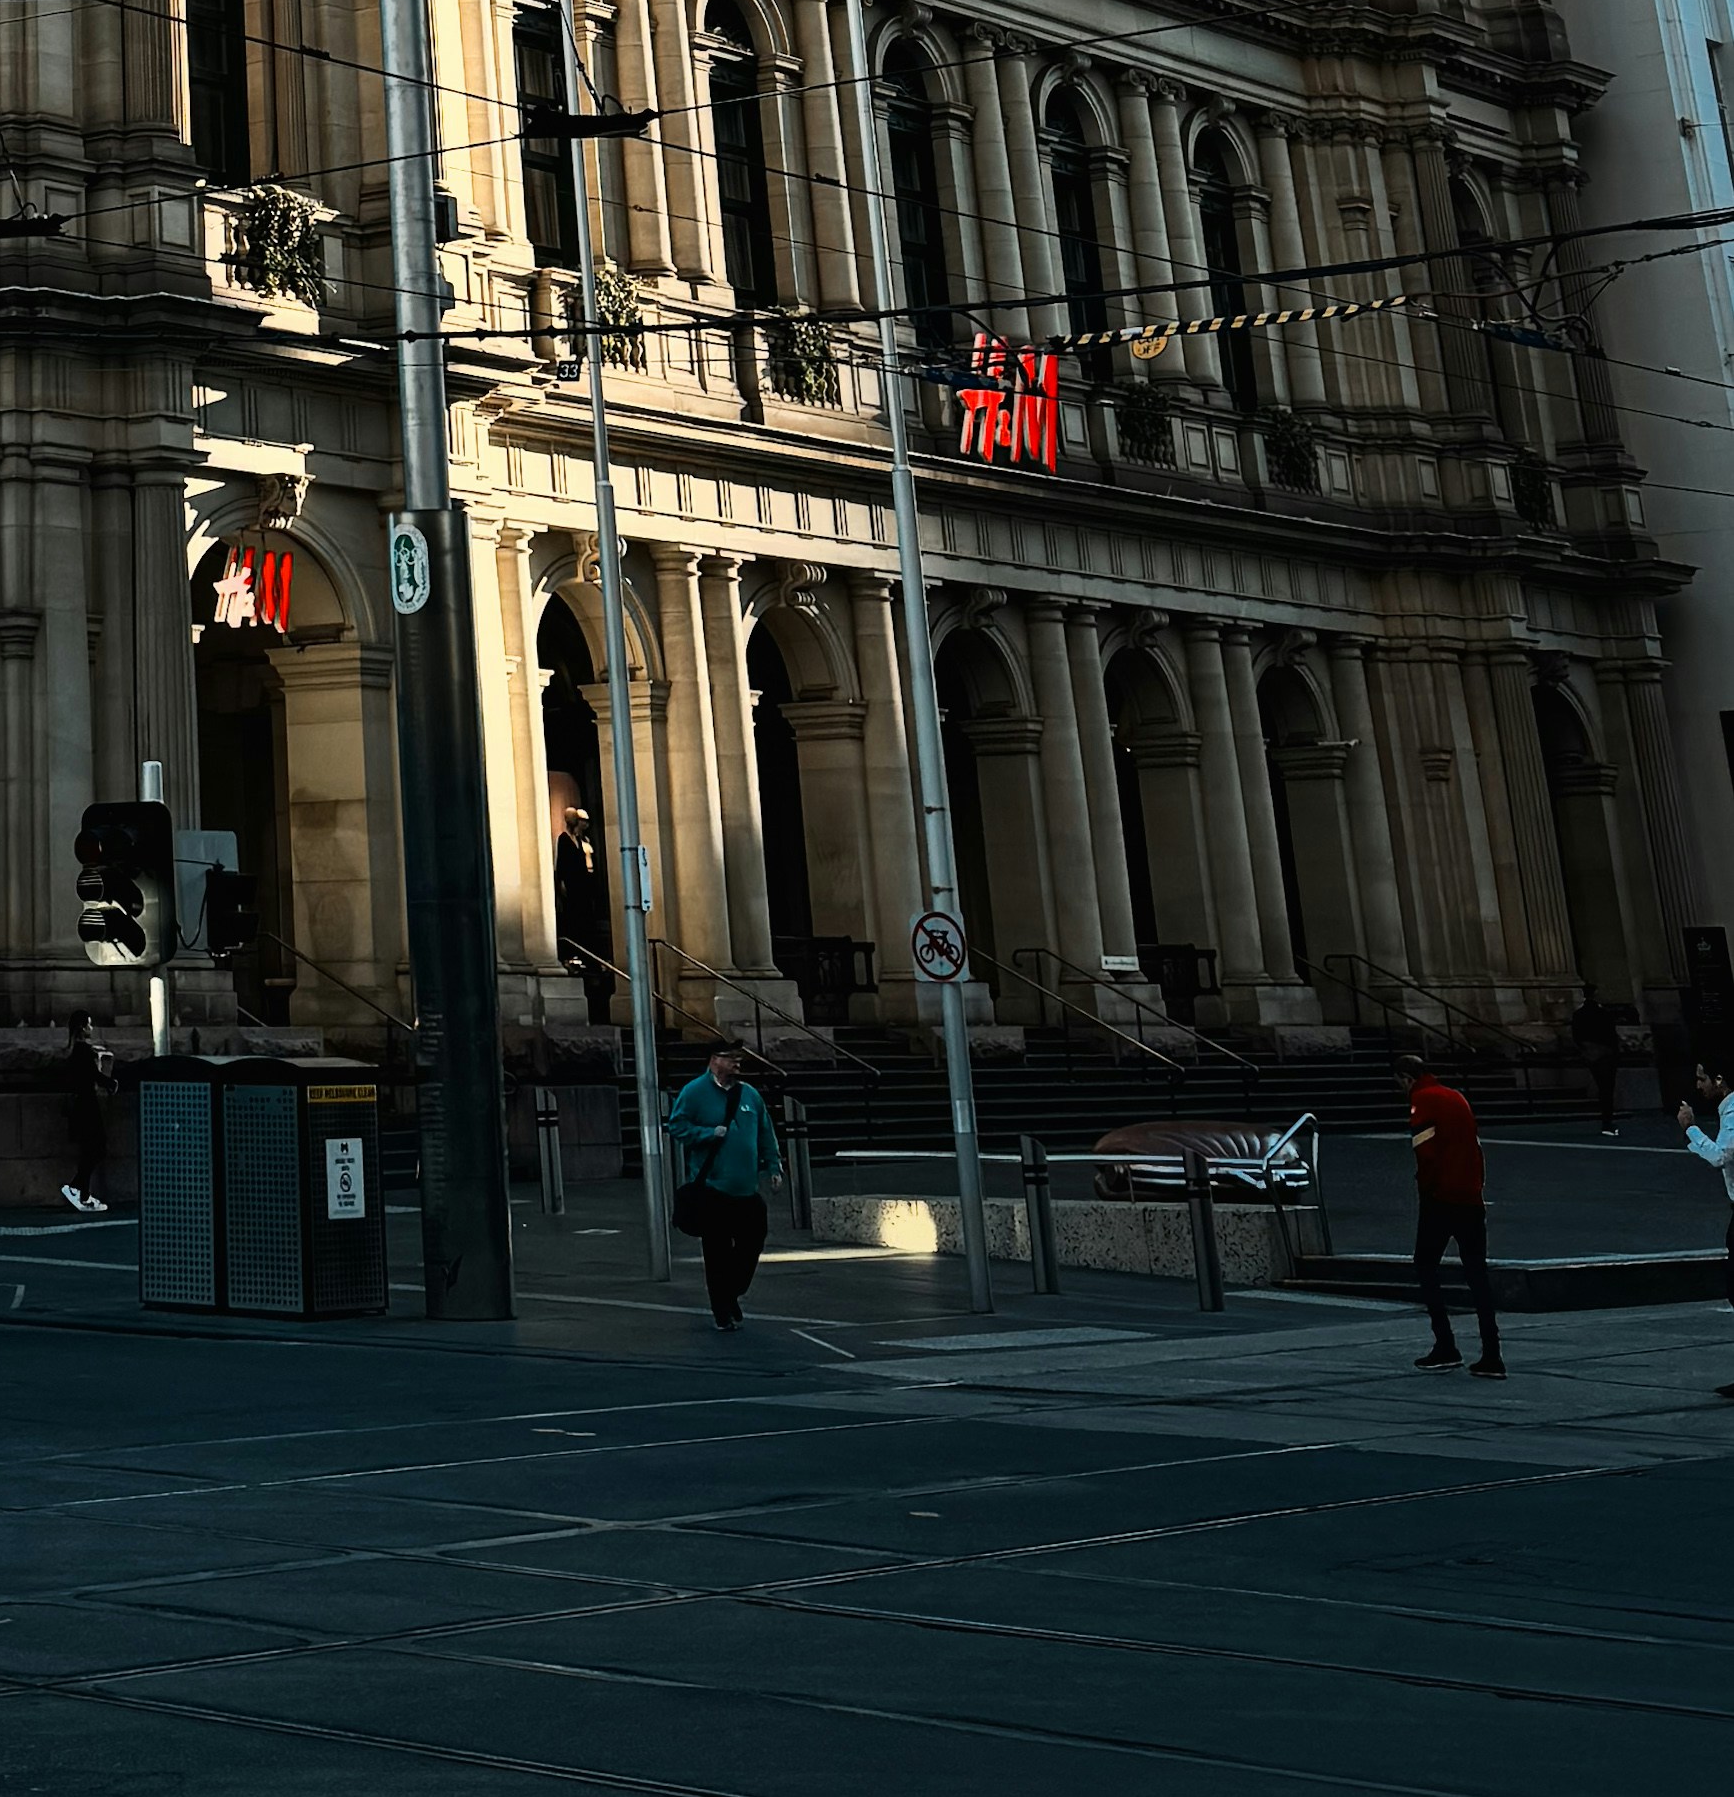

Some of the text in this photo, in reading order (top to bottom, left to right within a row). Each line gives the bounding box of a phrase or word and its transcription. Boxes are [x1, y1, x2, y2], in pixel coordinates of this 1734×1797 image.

[559, 364, 579, 378] 33
[956, 332, 1059, 475] H&M
[212, 545, 294, 634] H&M
